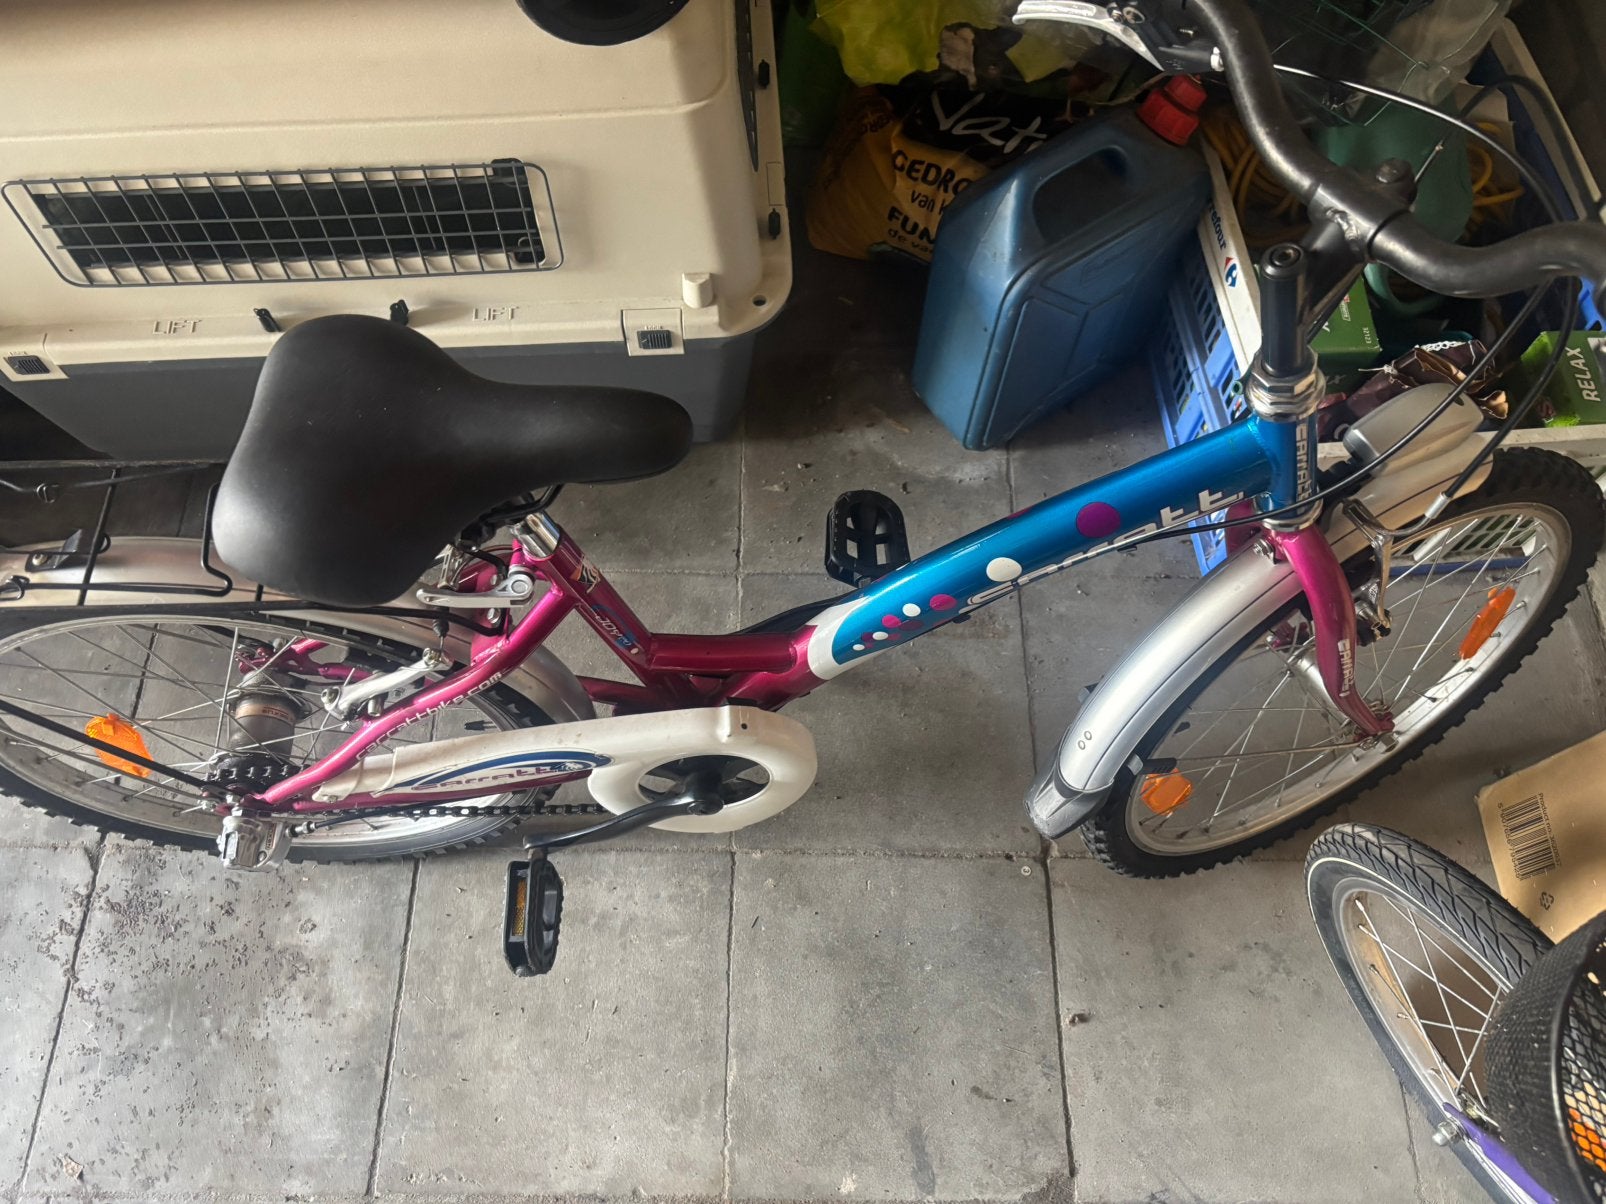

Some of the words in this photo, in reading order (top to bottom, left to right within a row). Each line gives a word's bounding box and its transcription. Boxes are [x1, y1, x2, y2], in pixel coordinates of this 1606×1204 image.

[911, 190, 935, 213] van
[472, 306, 520, 321] LIFT
[152, 319, 202, 335] LIFT
[1565, 346, 1601, 401] RELAX
[356, 671, 502, 761] carrattbike.com
[1538, 792, 1549, 822] Product
